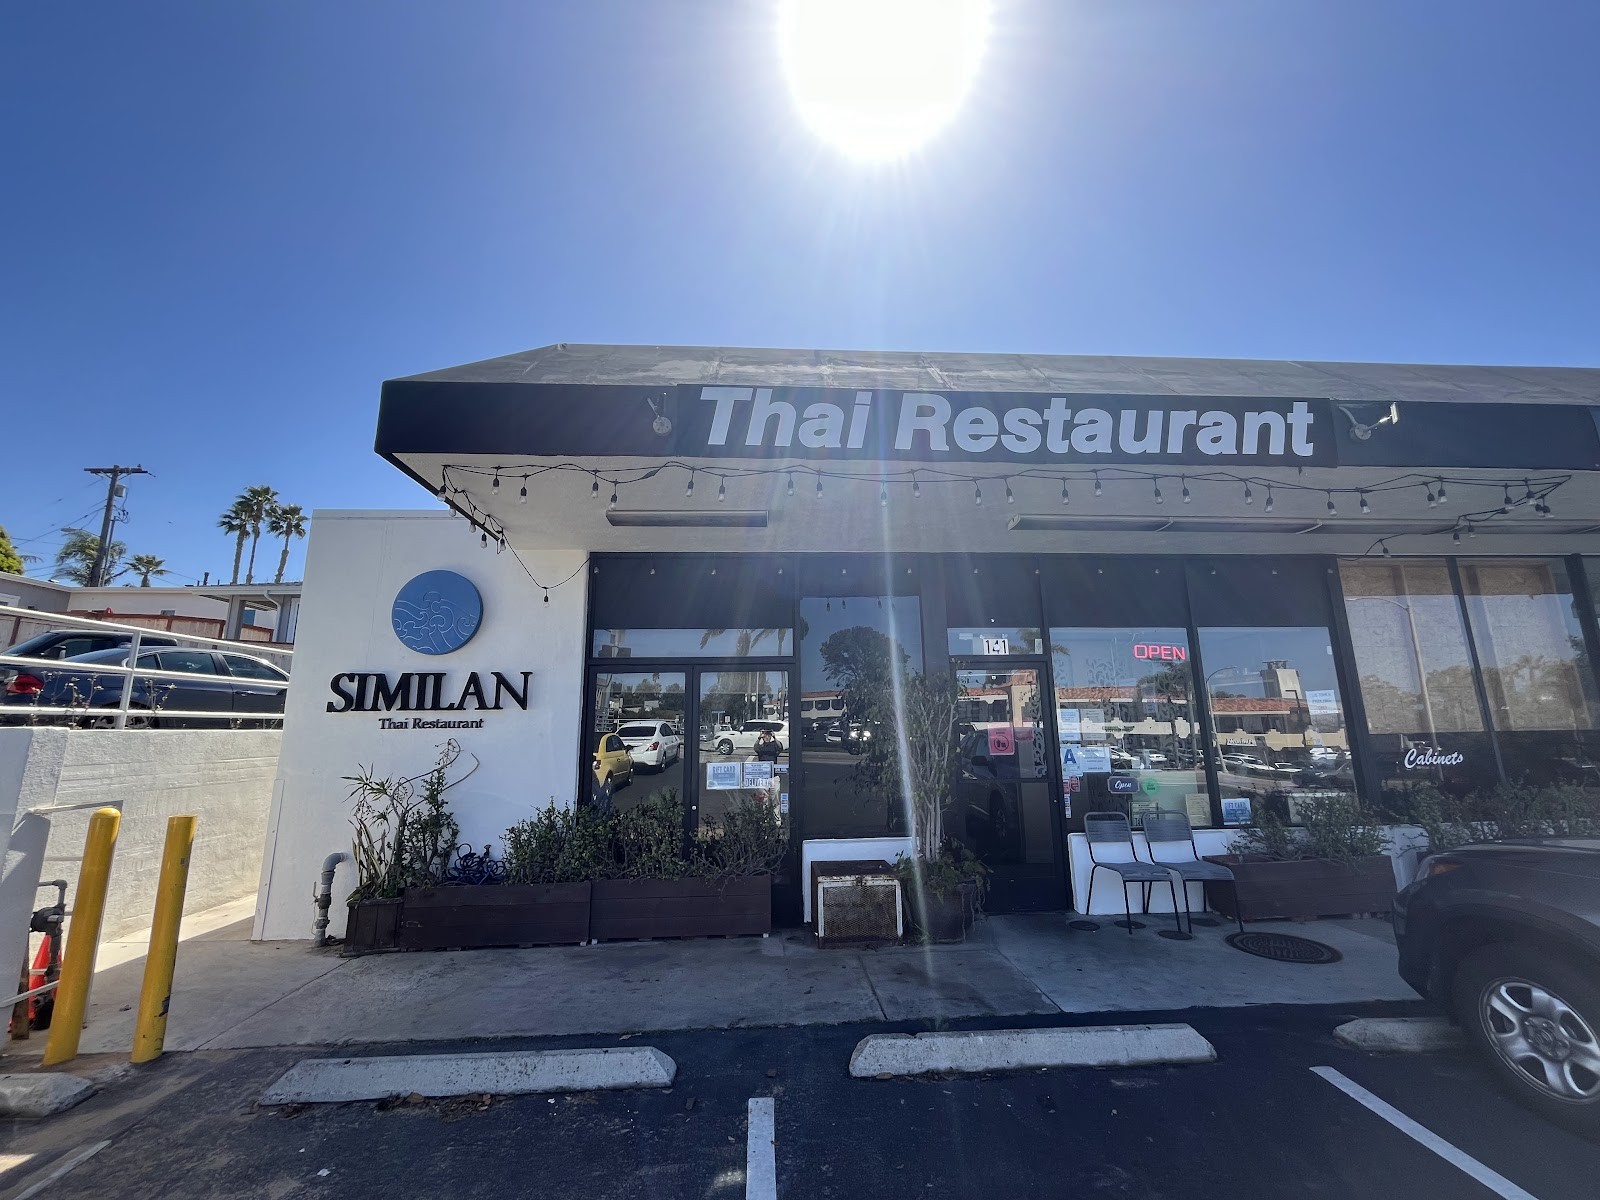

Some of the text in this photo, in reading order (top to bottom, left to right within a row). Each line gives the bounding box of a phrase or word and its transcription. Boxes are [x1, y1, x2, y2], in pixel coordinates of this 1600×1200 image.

[700, 387, 1314, 457] Thai Restaurant
[985, 640, 1007, 654] 141
[1133, 644, 1186, 660] OPEN
[326, 671, 533, 713] SIMILAN
[378, 718, 484, 729] Thai Restaurant
[1064, 748, 1077, 764] A
[1404, 748, 1464, 768] Cabinets
[1114, 780, 1132, 789] Open
